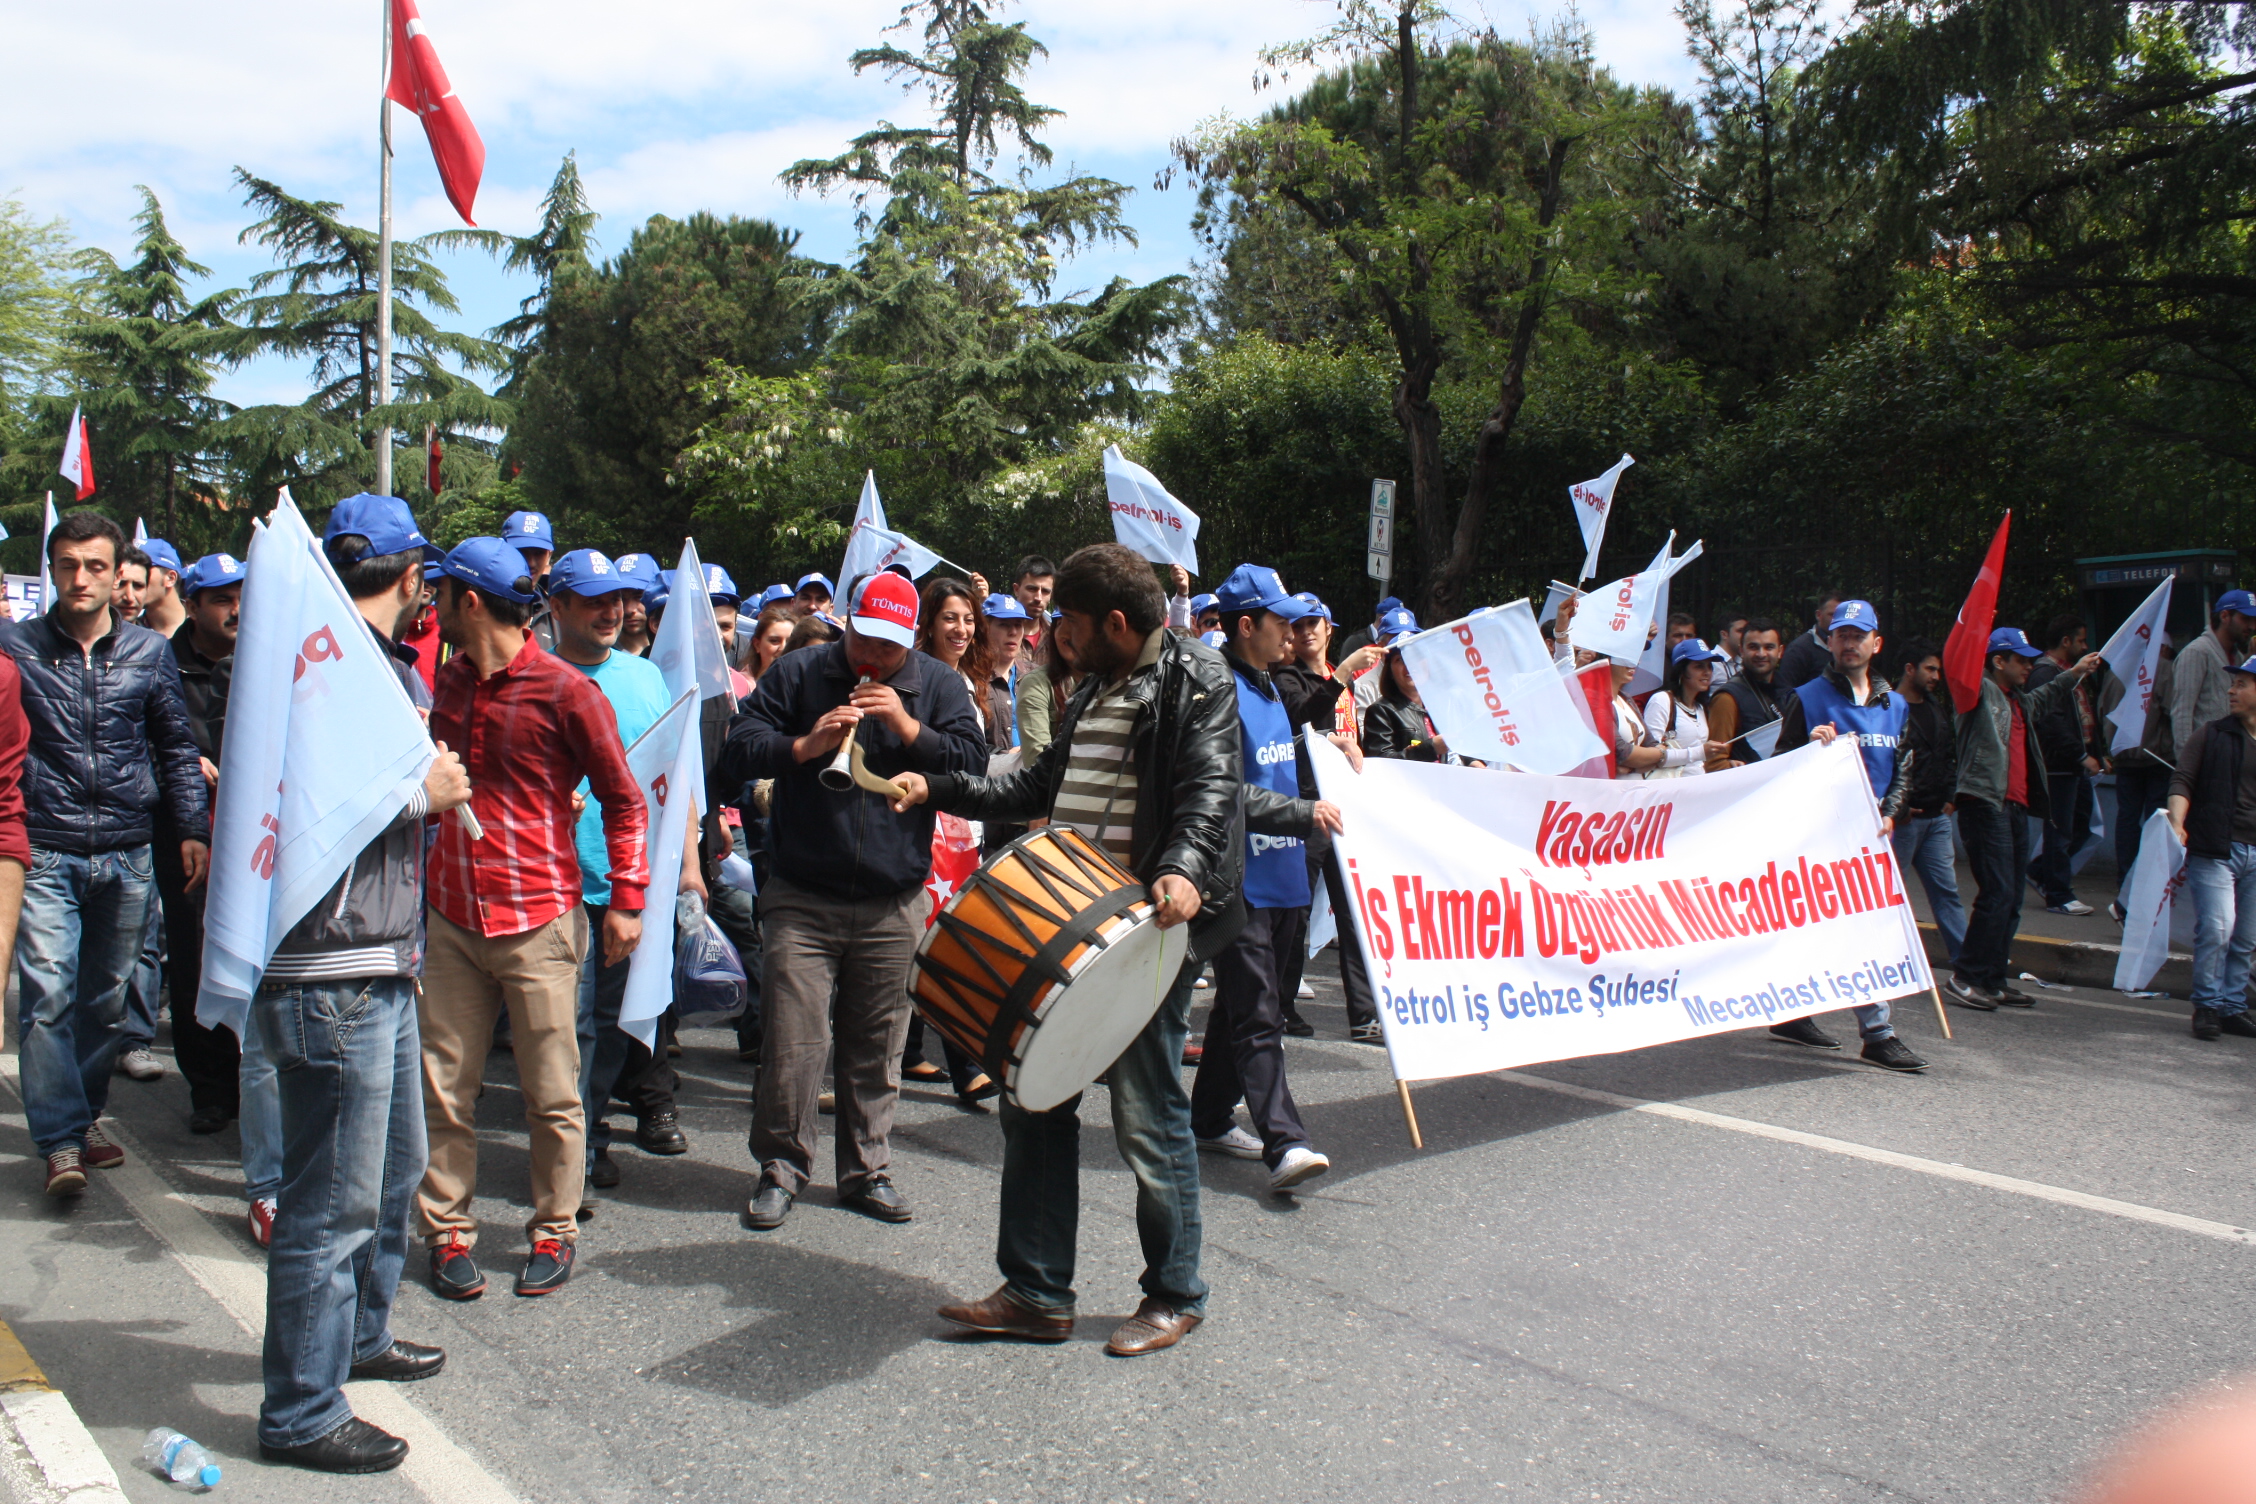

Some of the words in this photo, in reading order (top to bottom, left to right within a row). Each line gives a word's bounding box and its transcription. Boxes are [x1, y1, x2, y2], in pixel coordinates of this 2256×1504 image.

[871, 597, 913, 618] TÜMTİS
[1609, 574, 1639, 632] rol-iş
[2123, 567, 2177, 581] TELEFON
[1451, 622, 1521, 746] petrol-iş
[1535, 800, 1673, 881] Yaşasın
[1347, 858, 1395, 979] İş
[1392, 875, 1525, 960] Ekmek
[1518, 867, 1686, 965] Özgürlük
[1657, 846, 1905, 943] Mücadelemiz
[1462, 984, 1490, 1032] iş
[1497, 980, 1584, 1020] Gebze
[1588, 969, 1681, 1018] Şubesi
[1681, 974, 1827, 1027] Mecaplast
[1823, 954, 1918, 1004] işçileri
